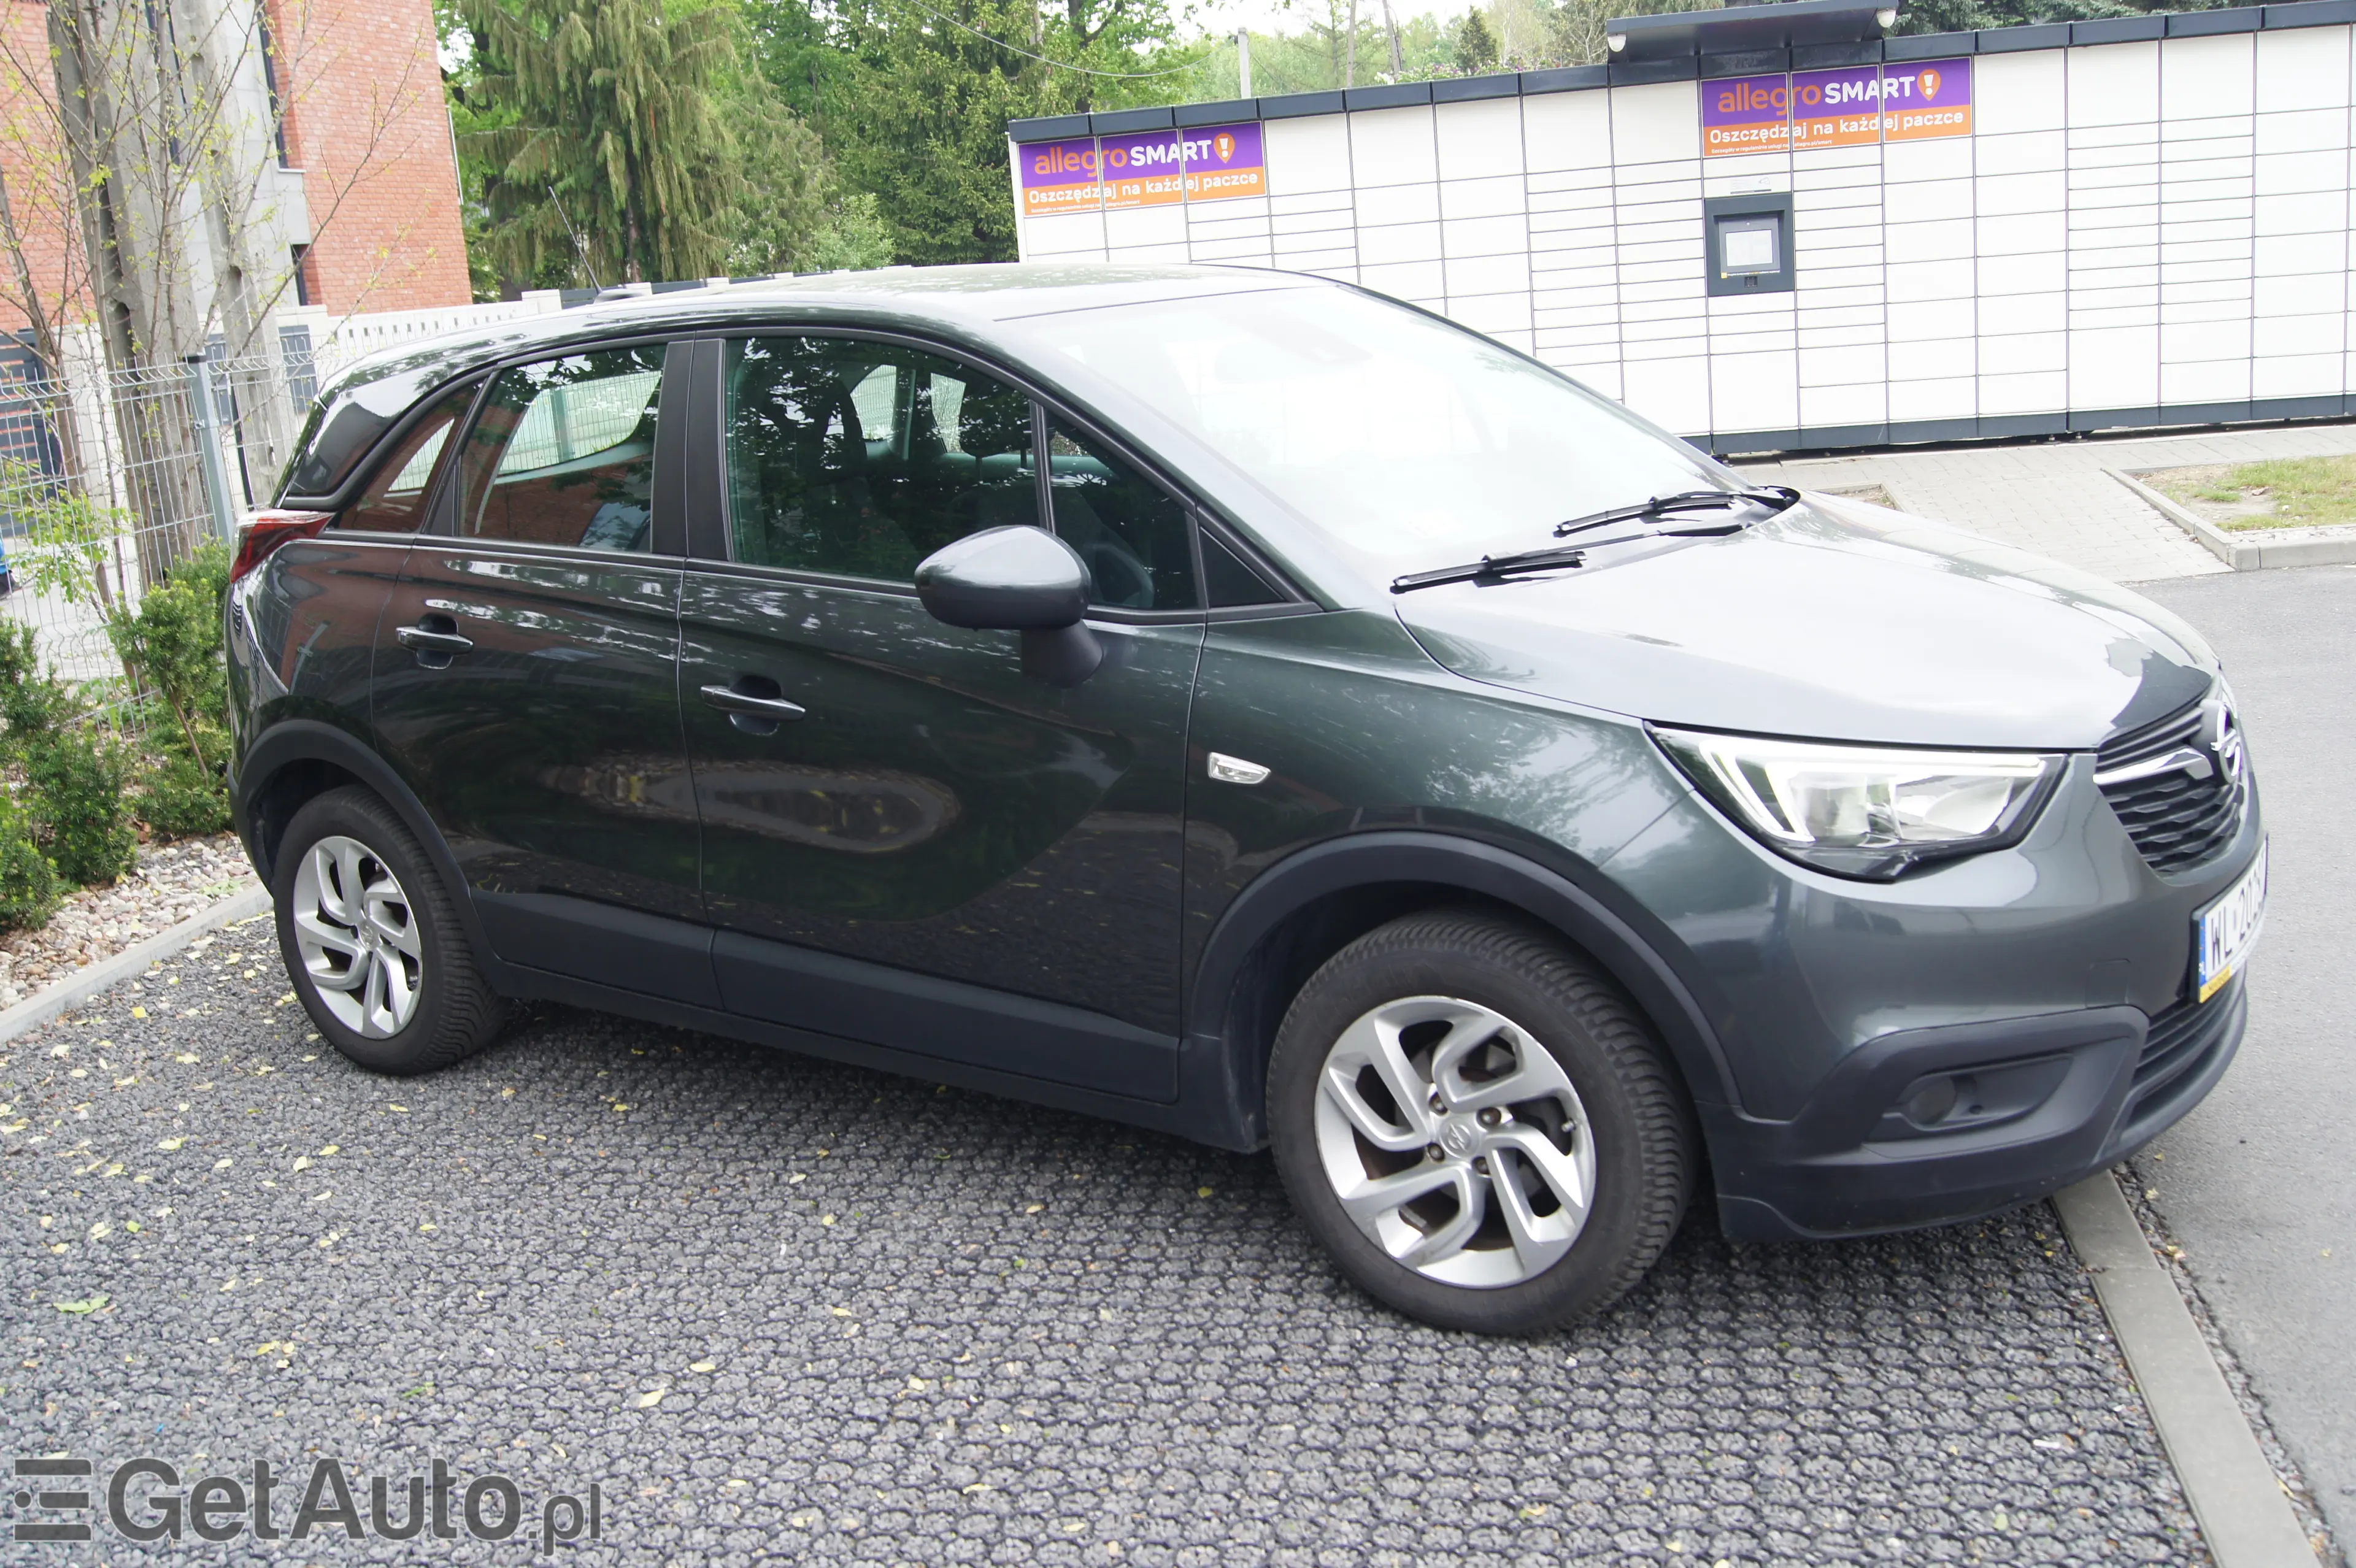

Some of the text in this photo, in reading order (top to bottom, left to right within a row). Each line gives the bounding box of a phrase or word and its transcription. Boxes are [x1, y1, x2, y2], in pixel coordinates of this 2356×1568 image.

[1718, 83, 1821, 116] allegro
[1710, 112, 1963, 143] Oszczędzaj na każdej paczce
[1034, 147, 1128, 177] allegro
[1029, 172, 1258, 204] Oszczędzaj na każdej paczce
